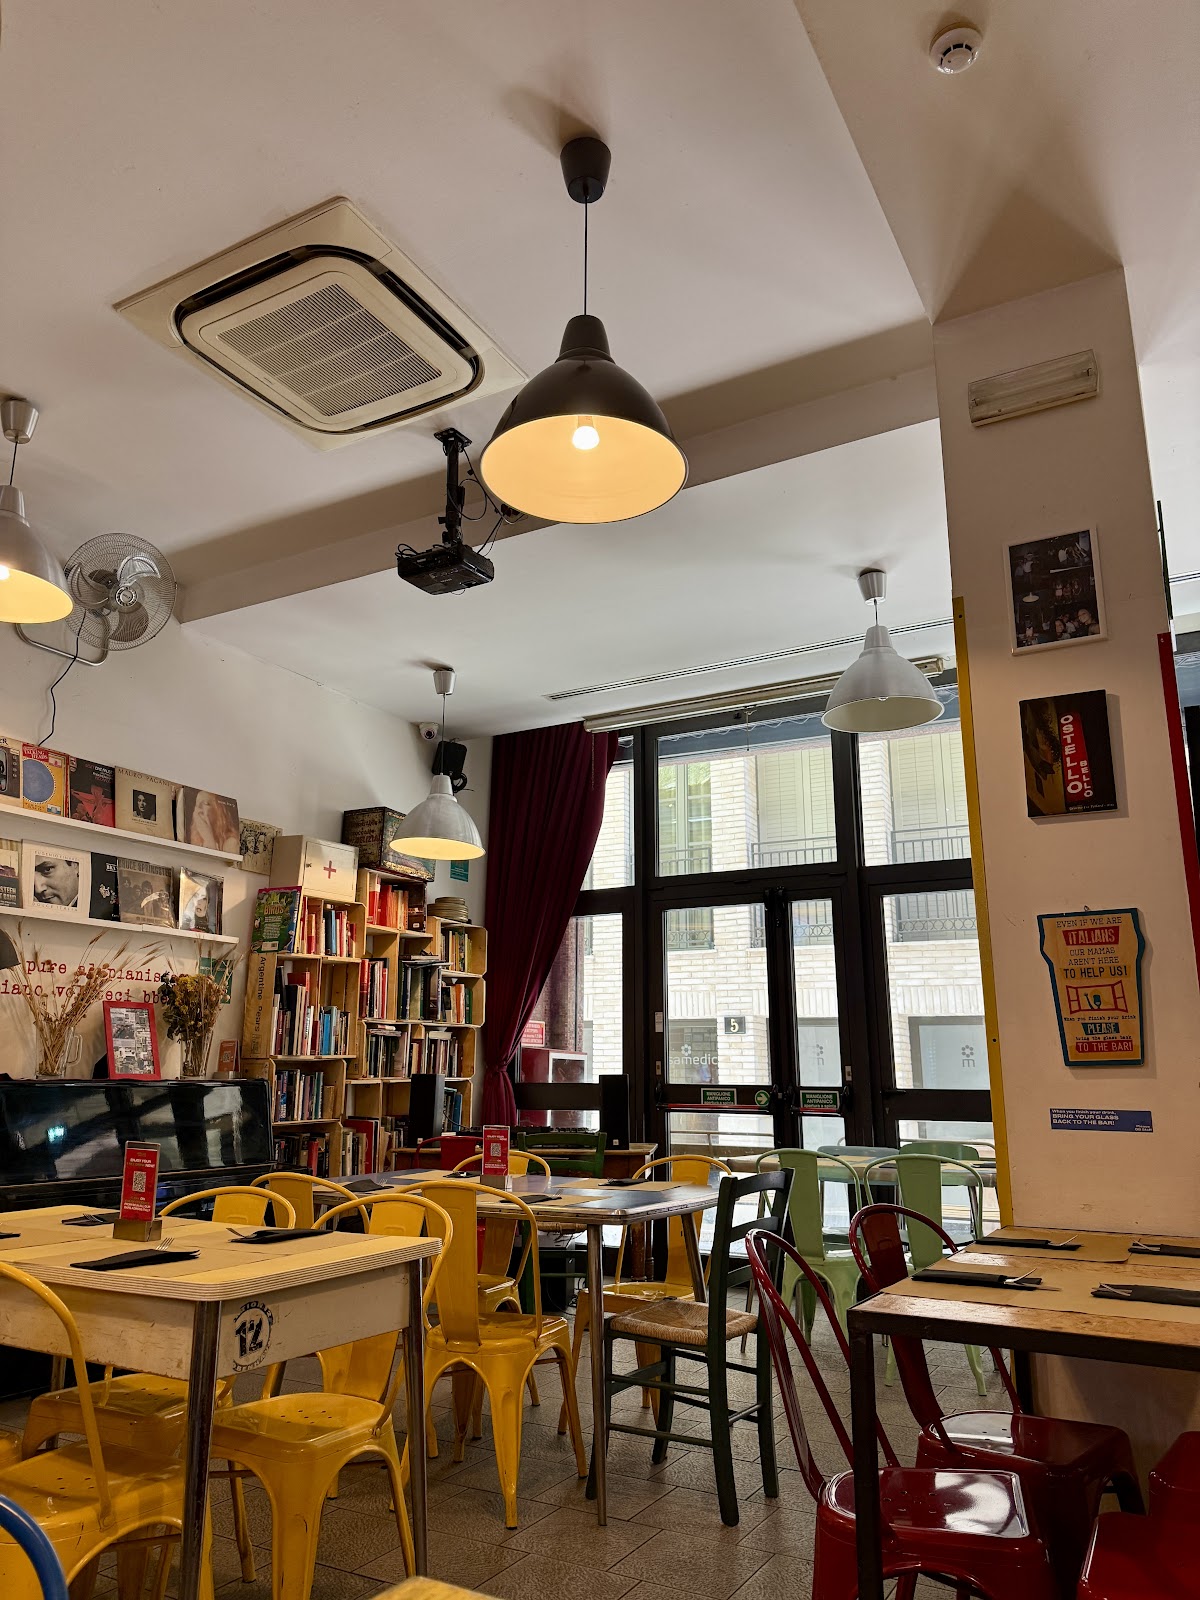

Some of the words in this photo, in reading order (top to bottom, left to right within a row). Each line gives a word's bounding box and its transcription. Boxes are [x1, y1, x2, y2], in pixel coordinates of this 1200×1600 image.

[1060, 714, 1083, 794] OSTELLO
[118, 768, 143, 780] MAURO
[146, 776, 171, 788] PAGANI
[1080, 760, 1093, 798] BELLO
[264, 905, 284, 915] BIRDS
[1056, 920, 1078, 928] EVEN
[1089, 918, 1104, 926] WE
[1106, 917, 1123, 925] ARE
[1067, 928, 1116, 945] ITALIANS
[1069, 948, 1085, 957] OUR
[1087, 947, 1116, 956] MAMAS
[26, 959, 67, 975] pure
[1068, 957, 1096, 966] AREN'T
[1098, 956, 1120, 964] HERE
[257, 956, 267, 1001] Argentine
[1063, 968, 1076, 979] TO
[1080, 966, 1105, 978] HELP
[1109, 965, 1128, 977] US!
[254, 1006, 263, 1032] Pears
[730, 1018, 739, 1033] 5
[1087, 1022, 1117, 1034] PLEASE
[1077, 1042, 1089, 1052] TO
[1091, 1041, 1109, 1051] THE
[1111, 1041, 1133, 1051] BAR!
[235, 1318, 263, 1358] 12
